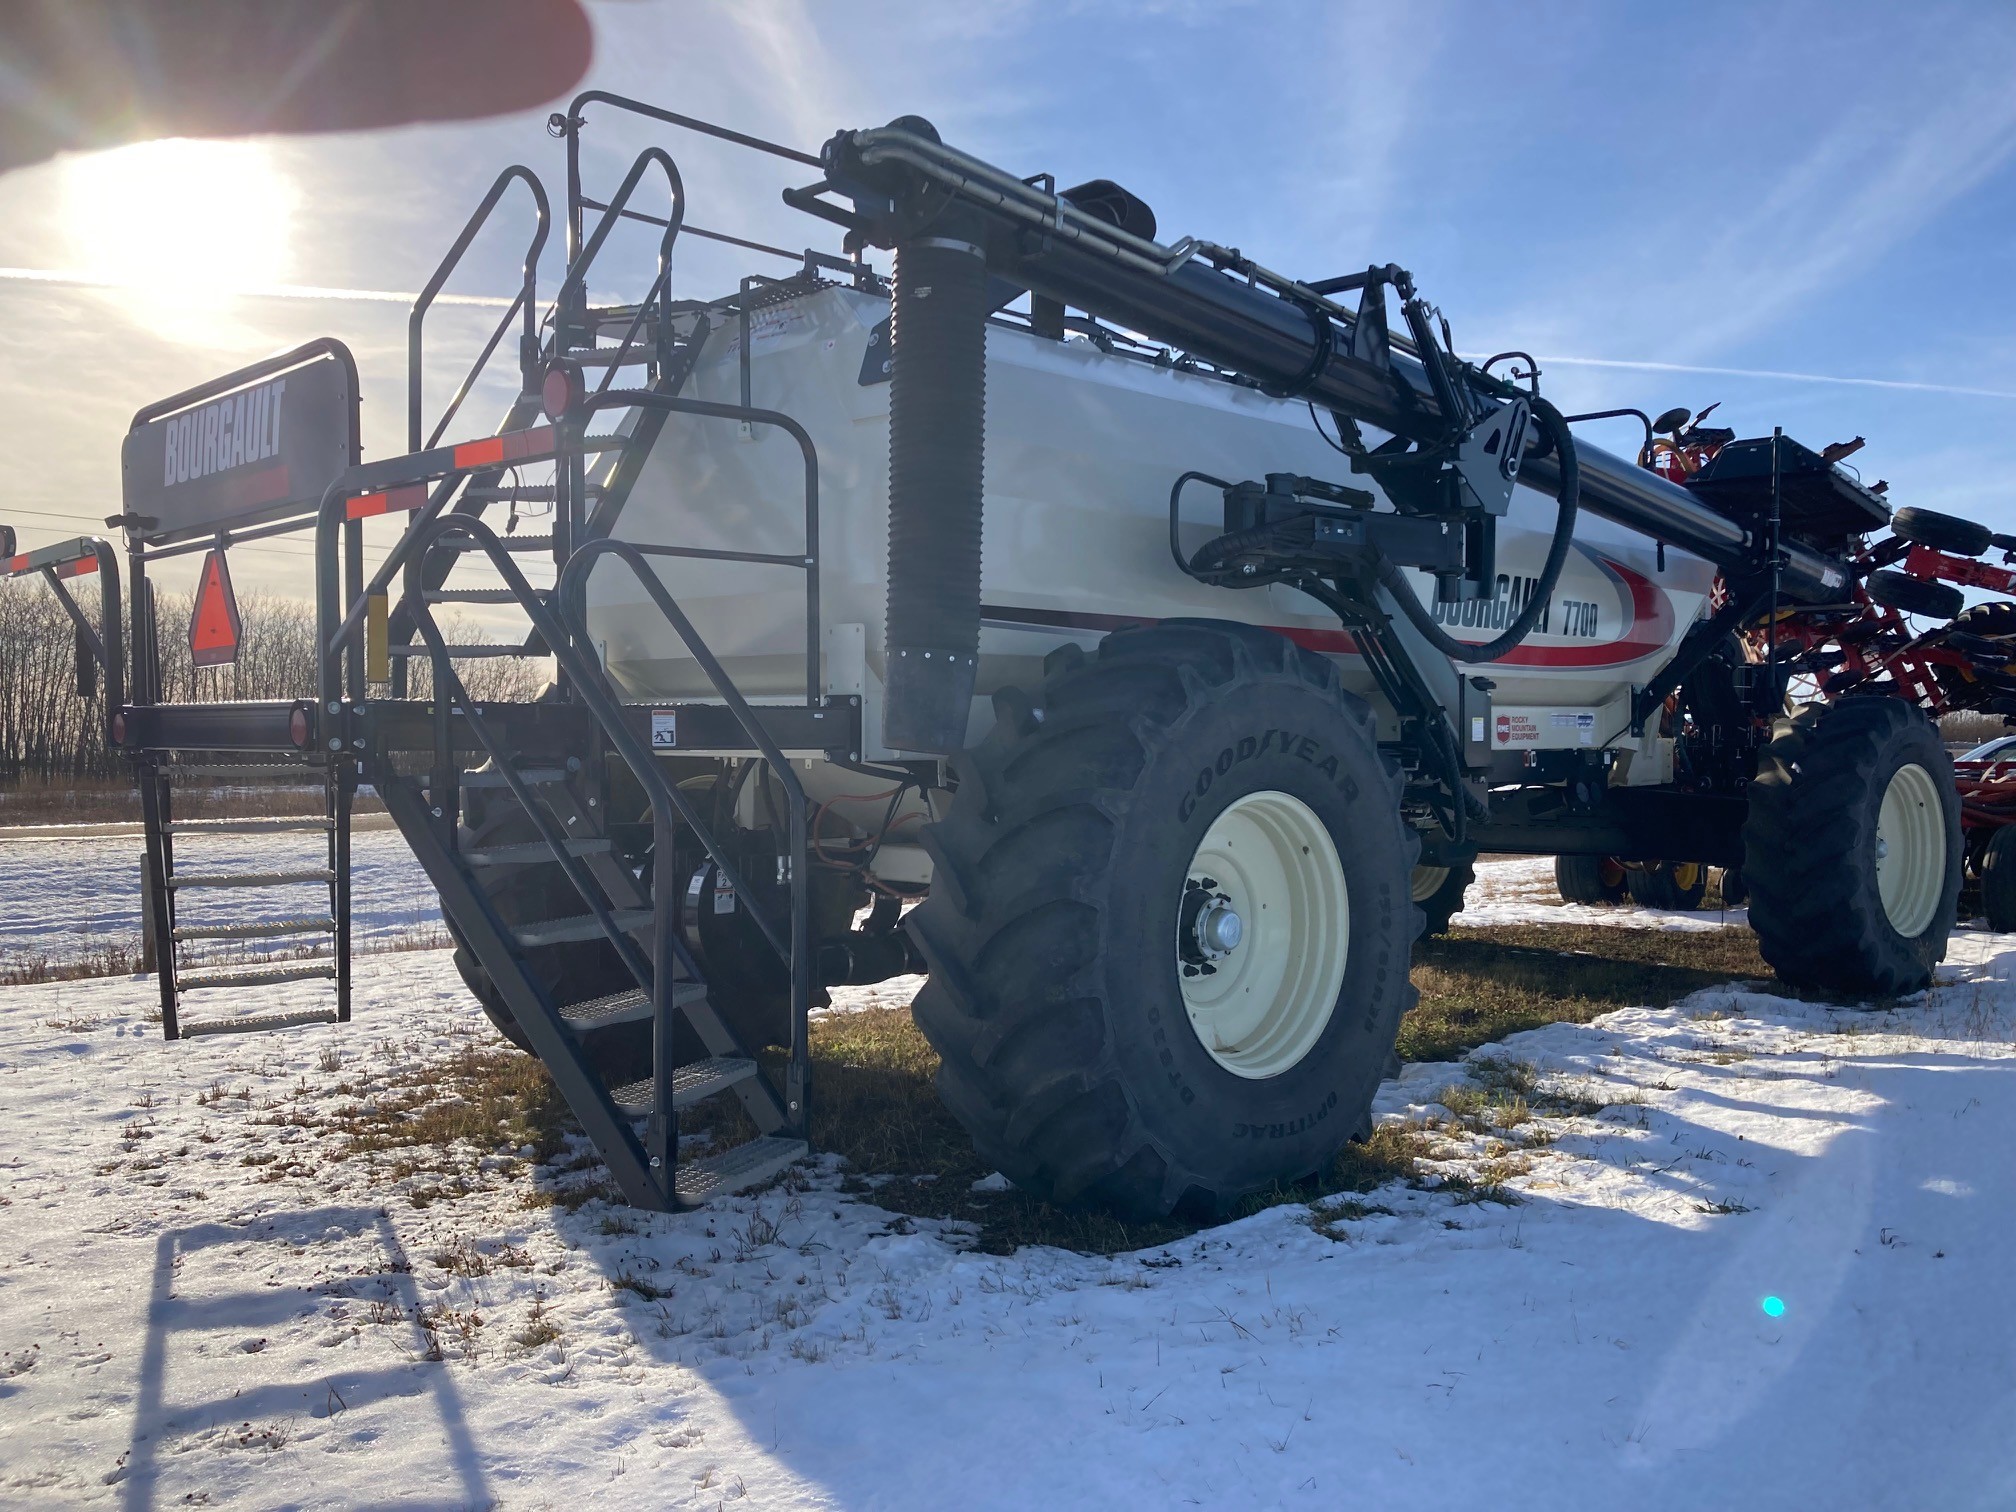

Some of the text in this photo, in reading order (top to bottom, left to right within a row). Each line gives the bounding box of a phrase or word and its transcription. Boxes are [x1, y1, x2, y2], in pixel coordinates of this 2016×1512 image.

[164, 379, 286, 487] BOURGAULT
[1563, 600, 1598, 637] 7700
[1178, 728, 1360, 823] GOODYEAR
[1232, 1090, 1338, 1139] OPTITRAC
